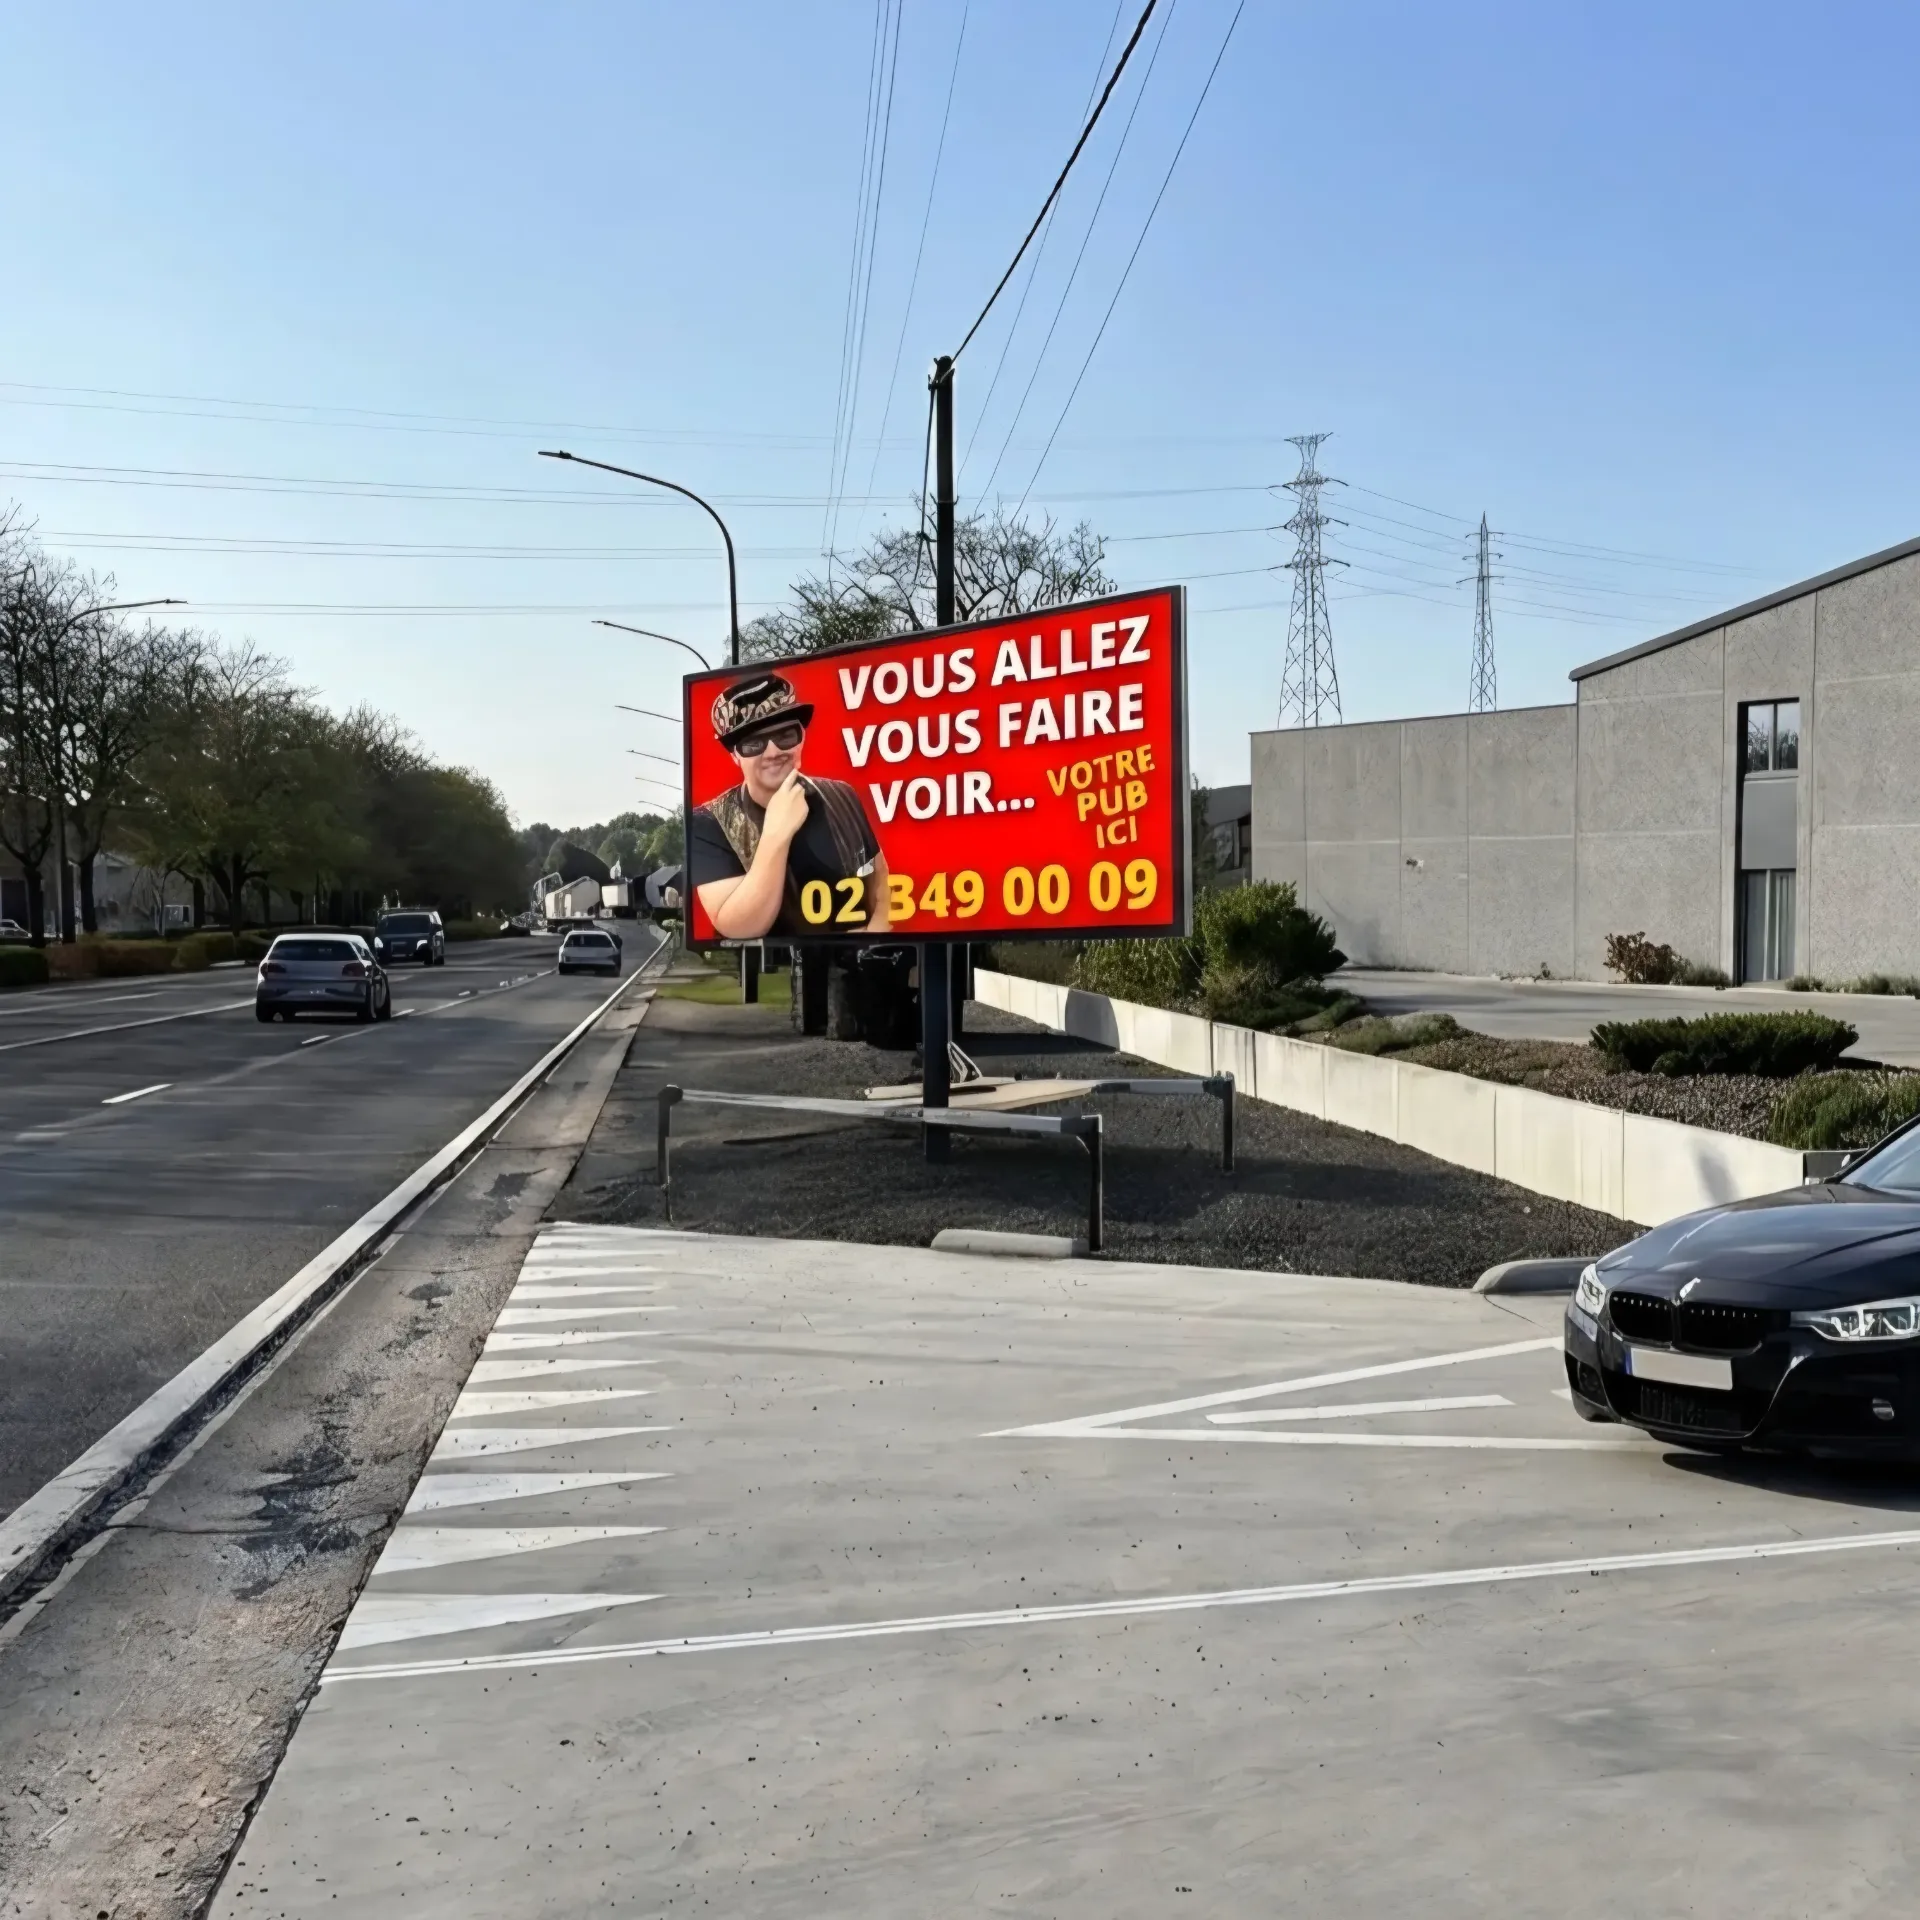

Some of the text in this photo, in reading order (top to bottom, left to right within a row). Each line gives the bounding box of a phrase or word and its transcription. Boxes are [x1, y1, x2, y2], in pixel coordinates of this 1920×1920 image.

[838, 615, 1151, 710] VOUS ALLEZ
[842, 683, 1145, 767] VOUS FAIRE
[869, 771, 1035, 823] VOIR...
[1046, 744, 1155, 797] VOTRE
[1077, 780, 1148, 822] PUB
[1096, 816, 1137, 848] ICI
[801, 859, 1158, 924] 02 349 00 09
